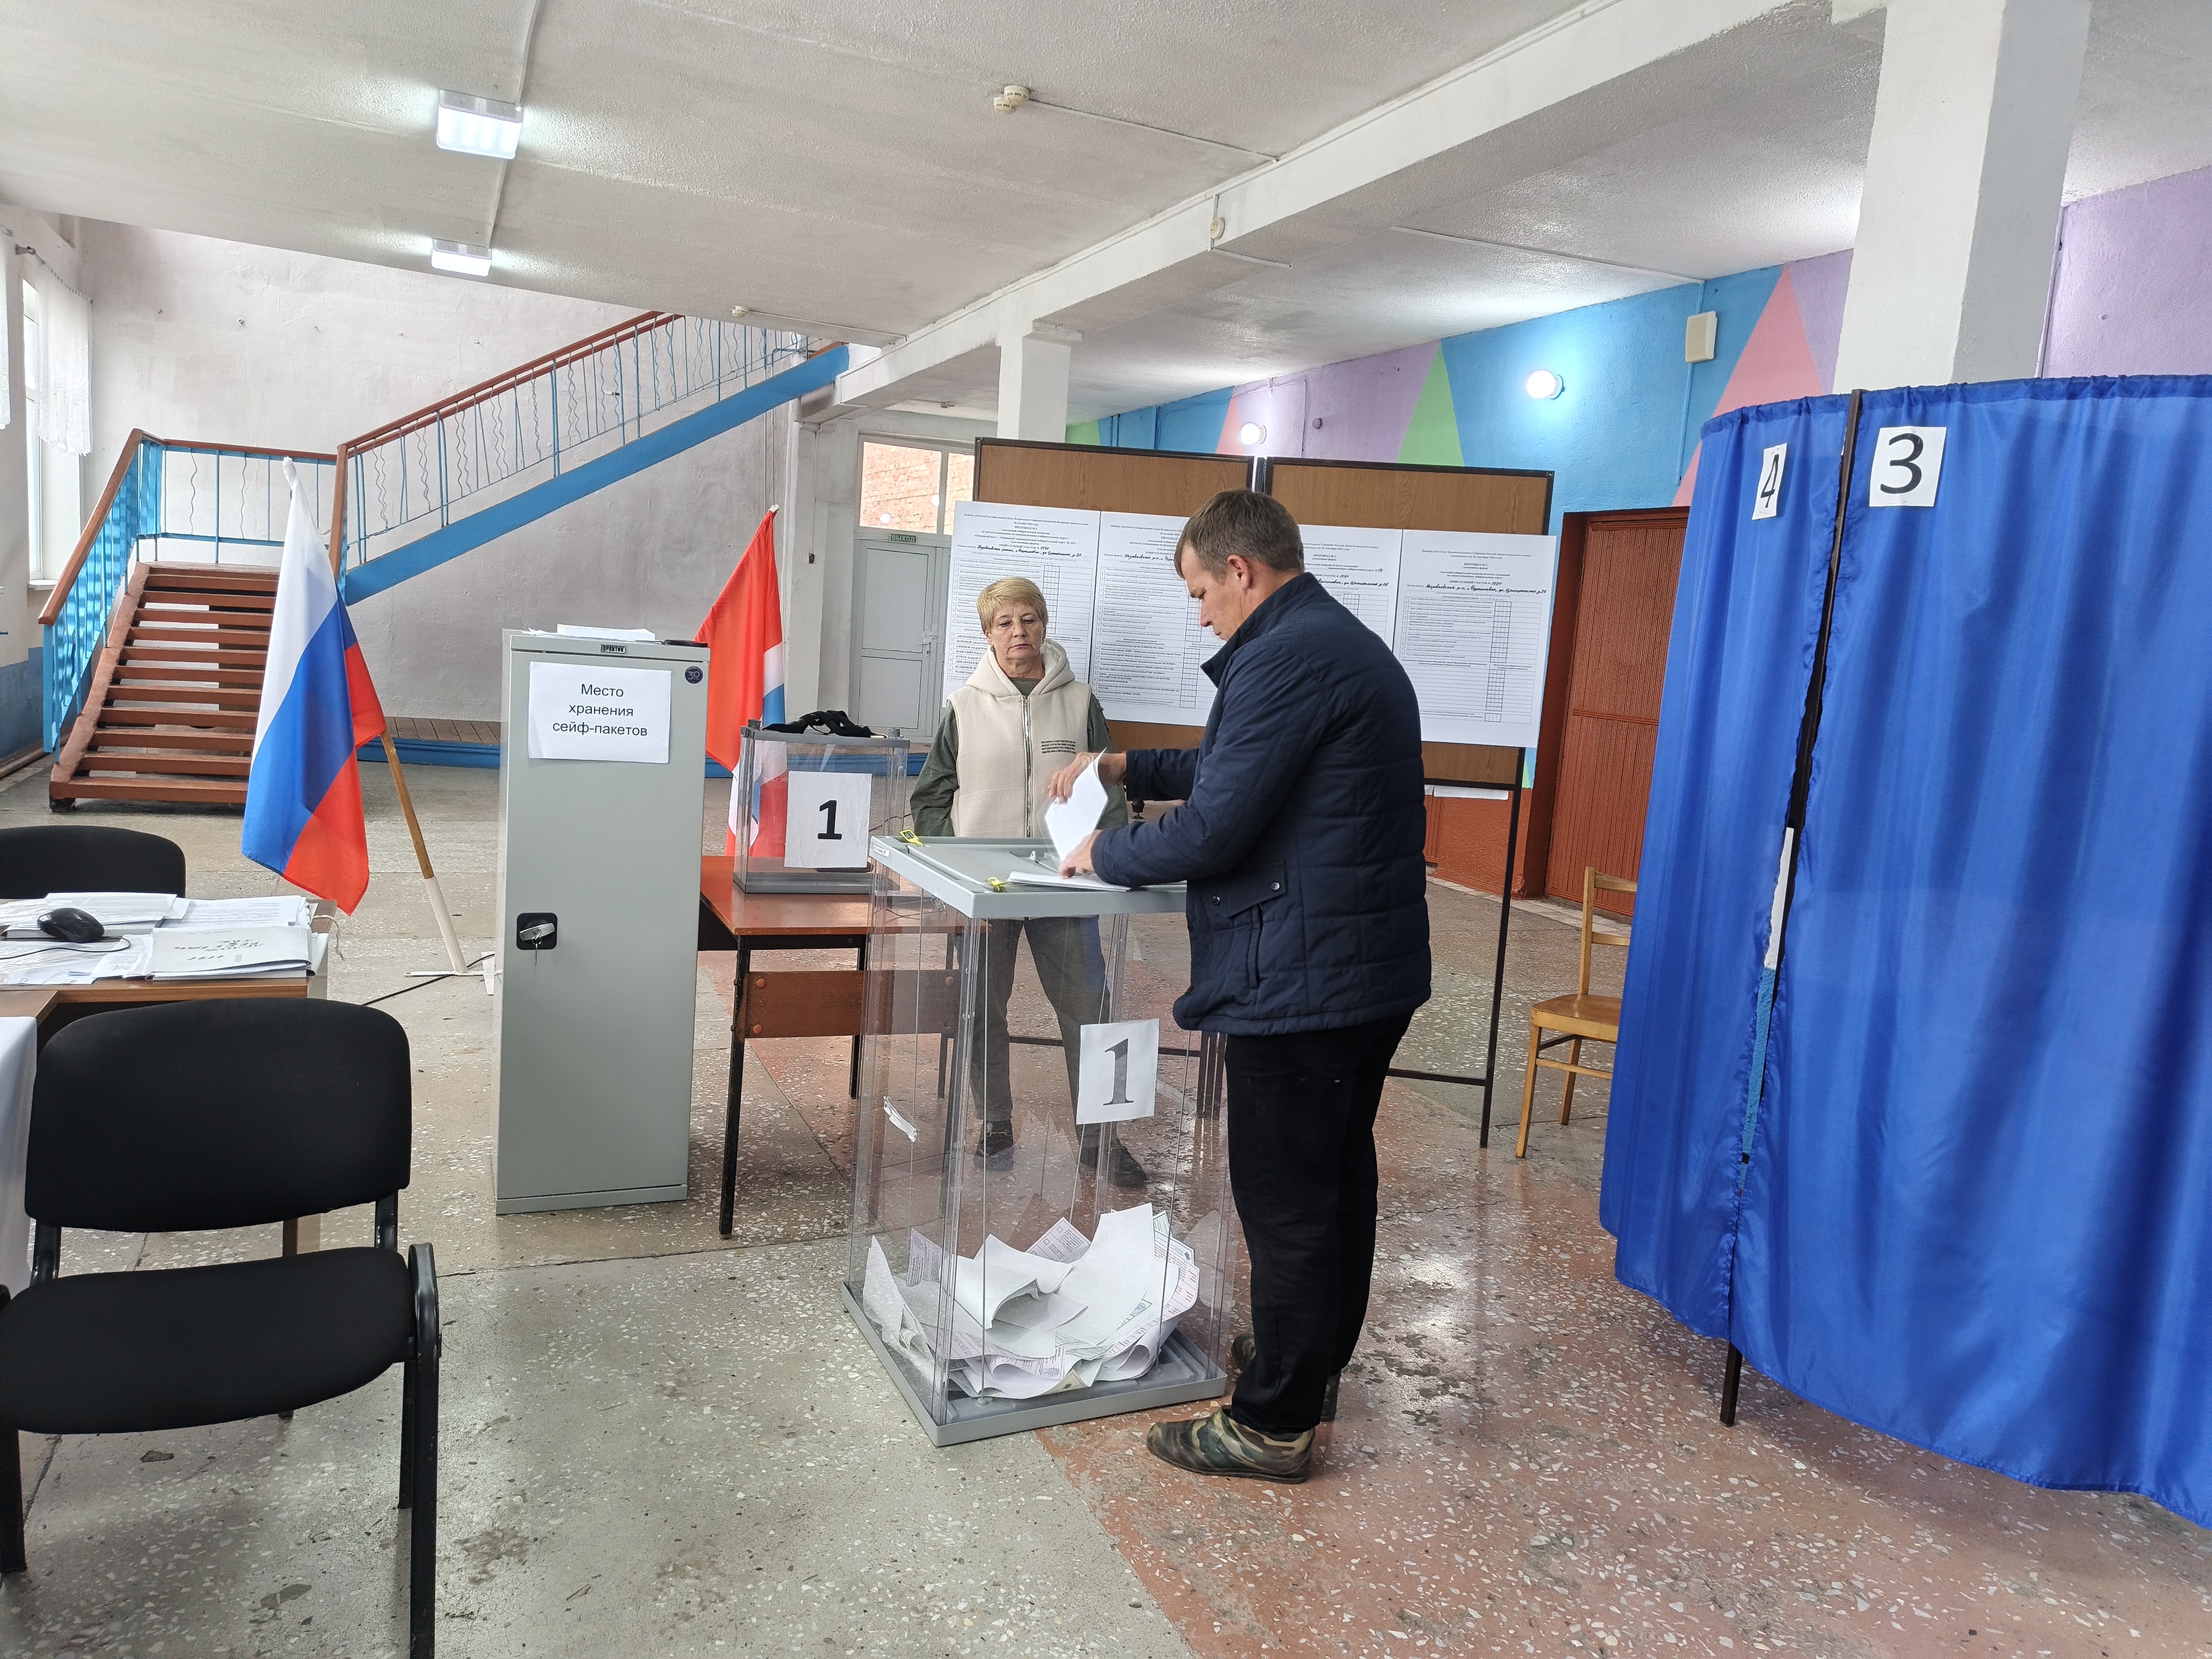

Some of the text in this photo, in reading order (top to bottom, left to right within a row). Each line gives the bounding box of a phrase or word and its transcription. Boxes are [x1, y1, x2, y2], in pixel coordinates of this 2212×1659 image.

[1880, 433, 1924, 494] 3
[1760, 454, 1780, 508] 4
[891, 534, 916, 543] ВЫХОД
[687, 671, 701, 680] 30
[581, 684, 624, 697] Место
[568, 704, 634, 717] хранения
[552, 721, 648, 736] сейф-пакетов
[818, 800, 842, 840] 1
[1103, 1038, 1134, 1105] 1
